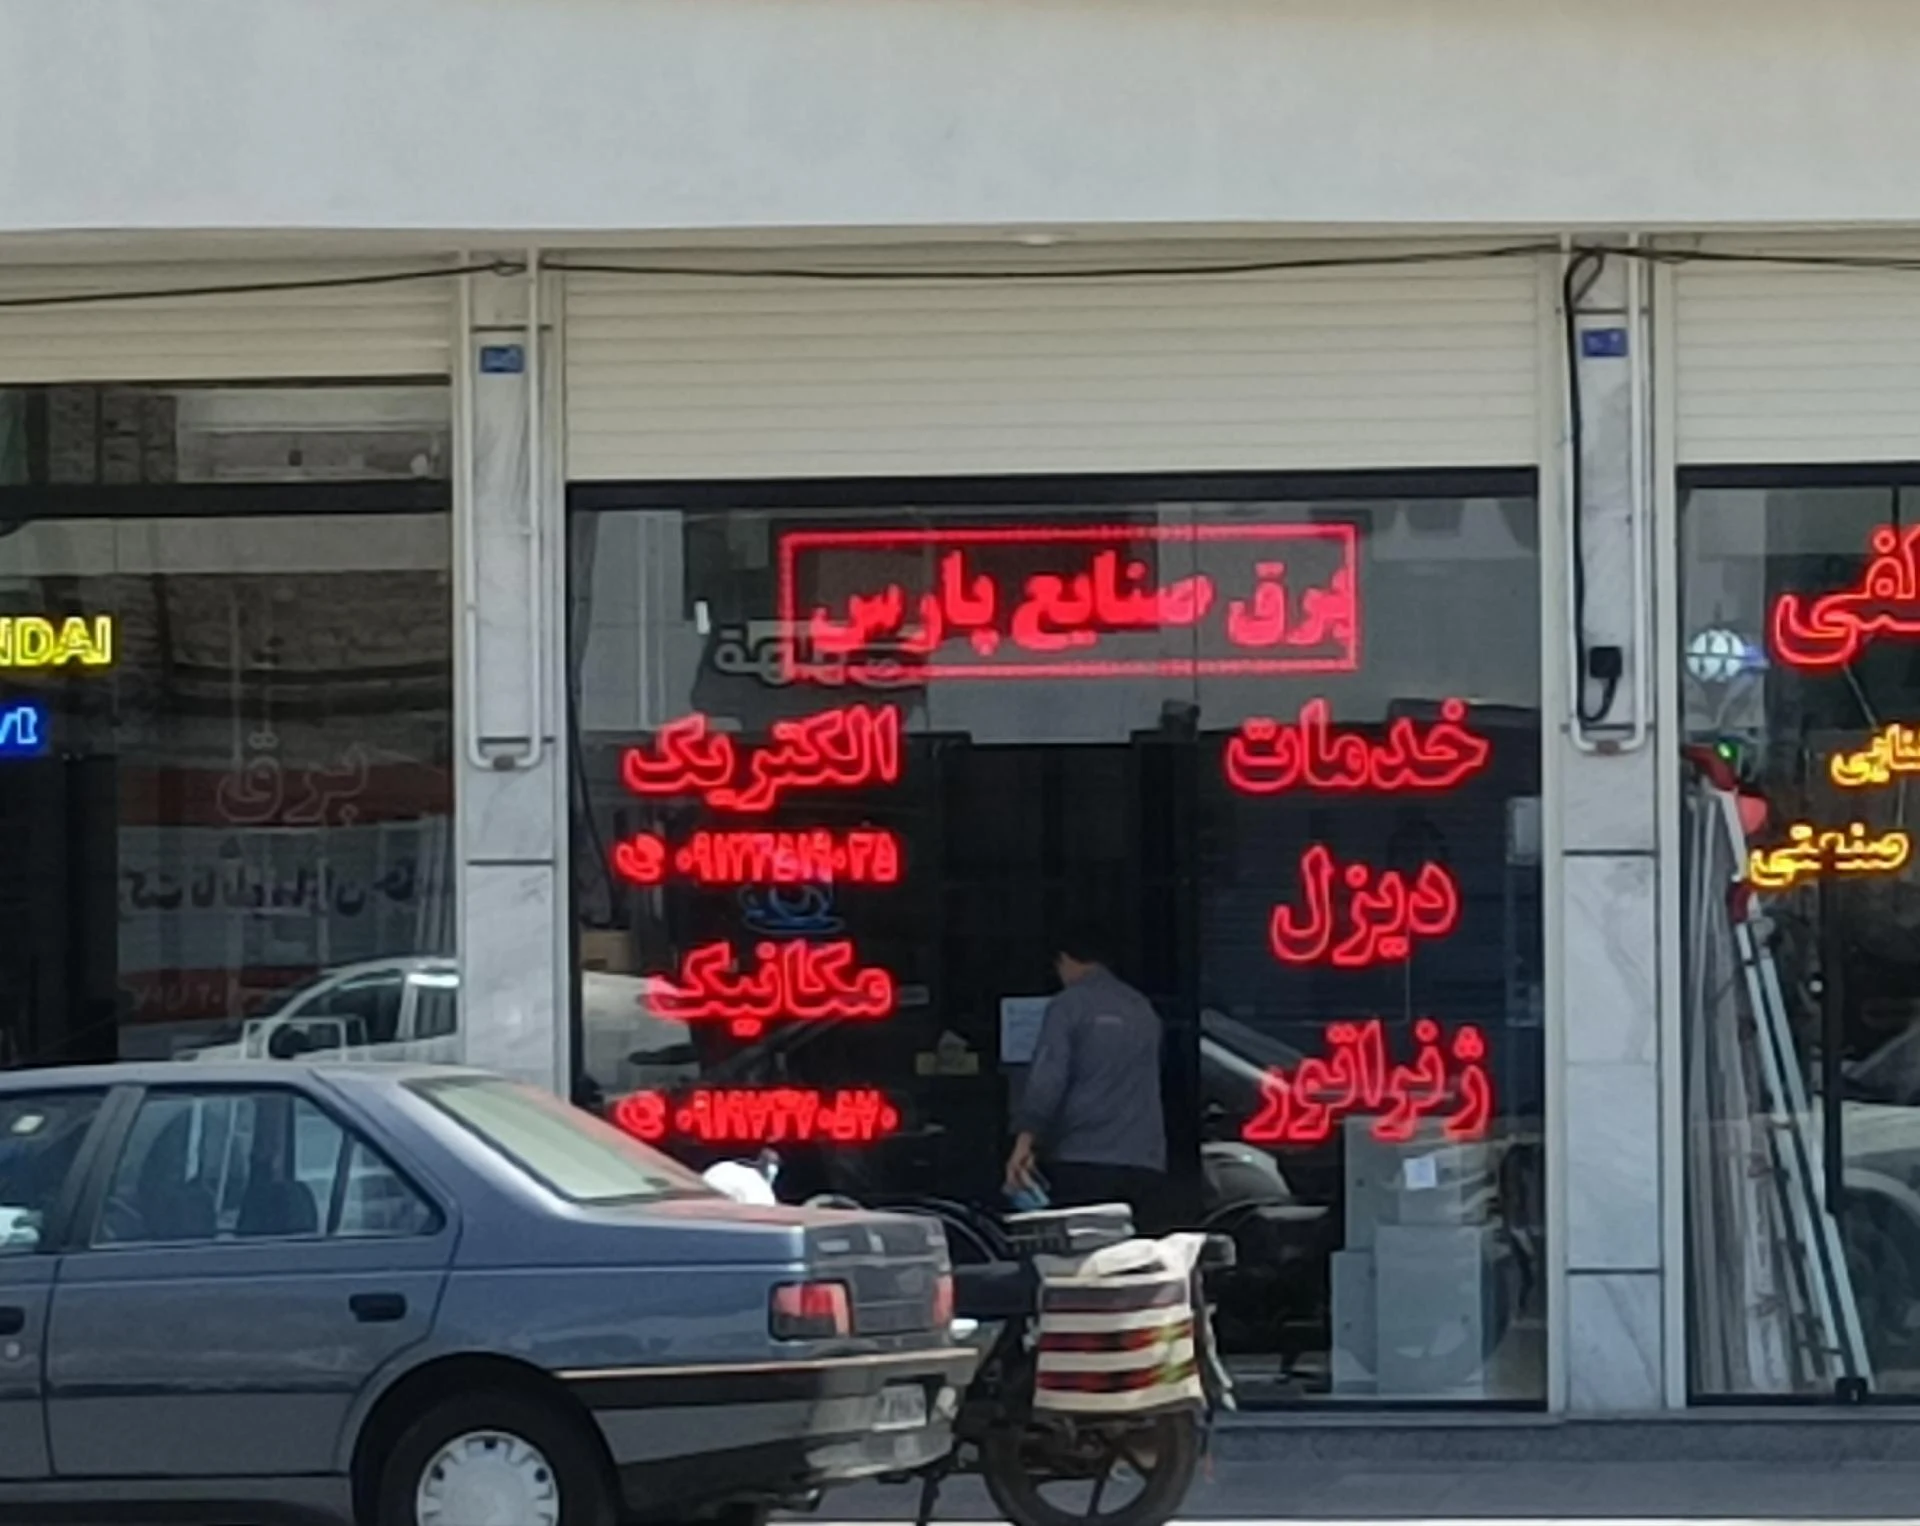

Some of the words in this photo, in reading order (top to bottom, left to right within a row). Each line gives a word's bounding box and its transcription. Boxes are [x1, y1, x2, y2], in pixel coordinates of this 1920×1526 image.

[809, 552, 1000, 656] پارس
[1012, 552, 1214, 650] صنایع
[1228, 562, 1356, 647] برق
[623, 704, 899, 812] الکتریک
[1226, 698, 1488, 792] خدمات
[1271, 846, 1458, 966] دیزل
[647, 940, 893, 1037] مکانیک
[1243, 1020, 1491, 1140] ژنراتور
